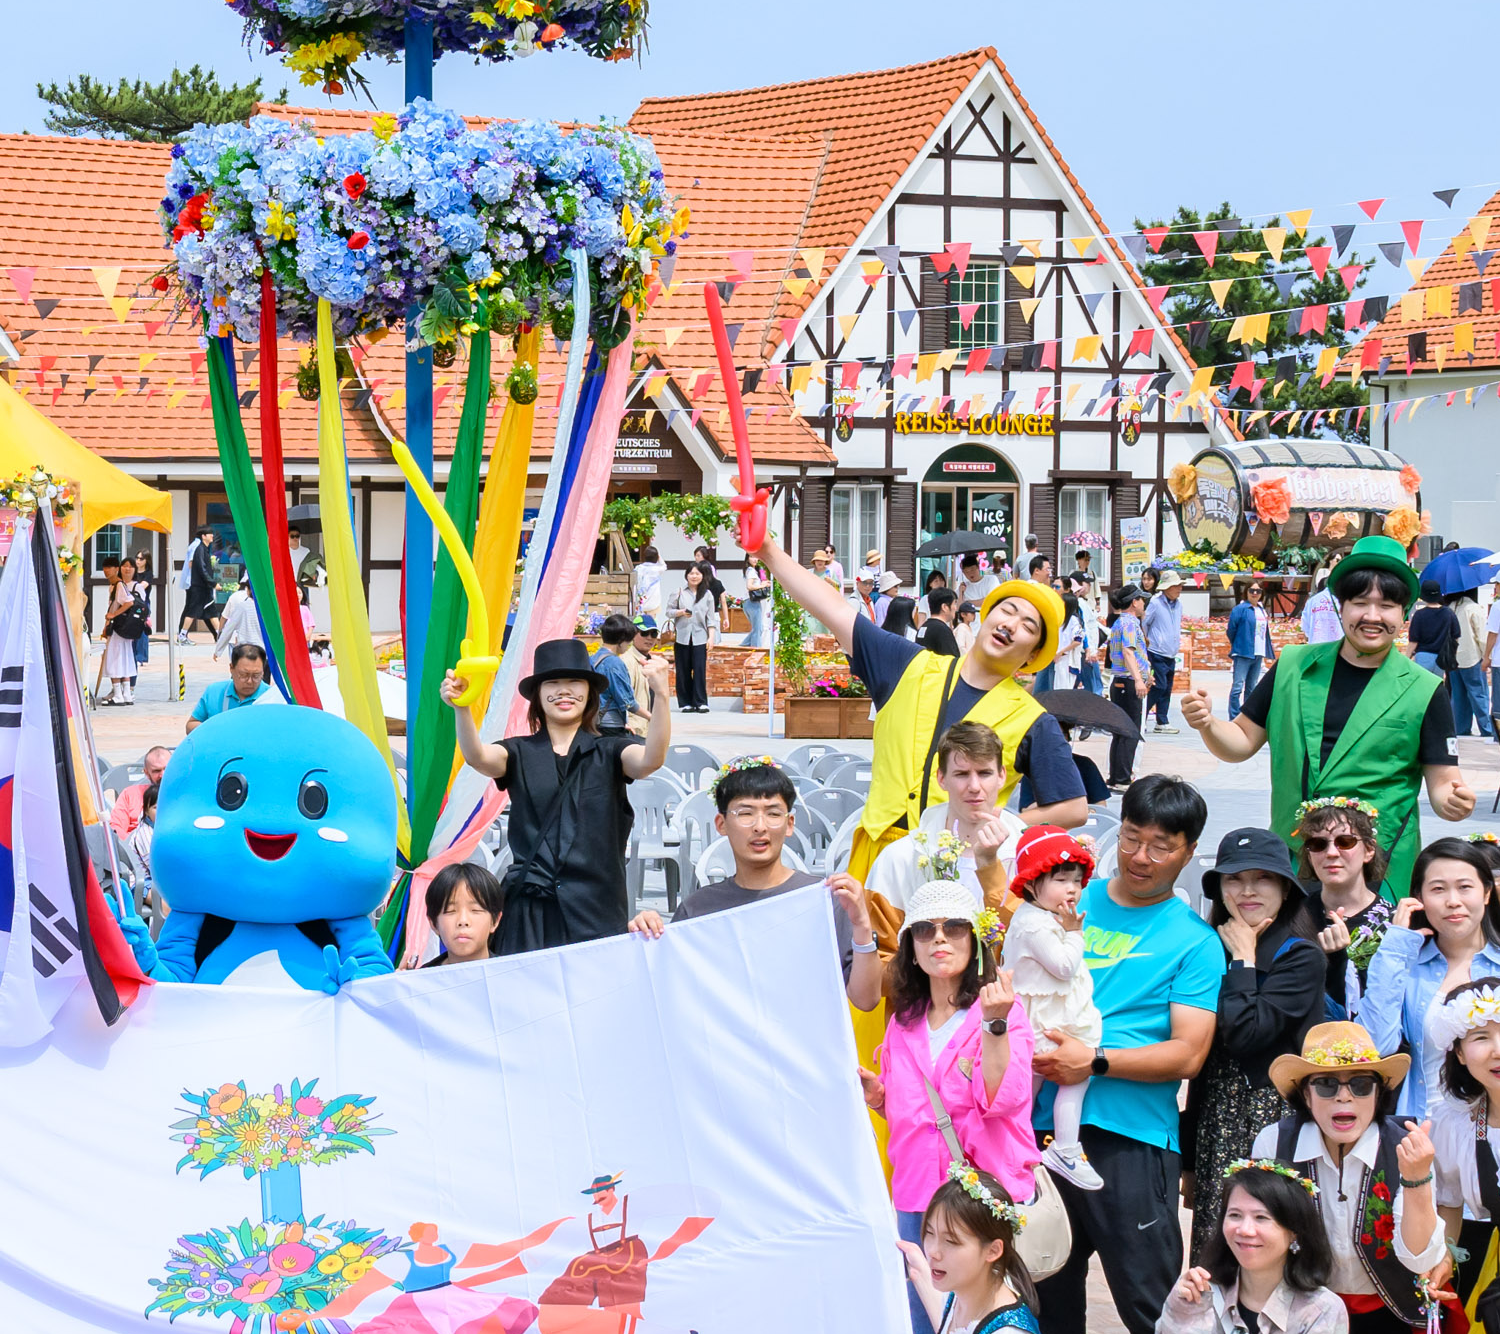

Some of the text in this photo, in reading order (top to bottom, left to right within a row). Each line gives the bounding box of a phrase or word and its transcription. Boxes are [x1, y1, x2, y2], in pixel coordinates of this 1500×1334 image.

[895, 412, 1056, 436] REISE-LOUNGE
[616, 438, 660, 448] EUTSCHES
[614, 449, 672, 458] TURZENTRUM
